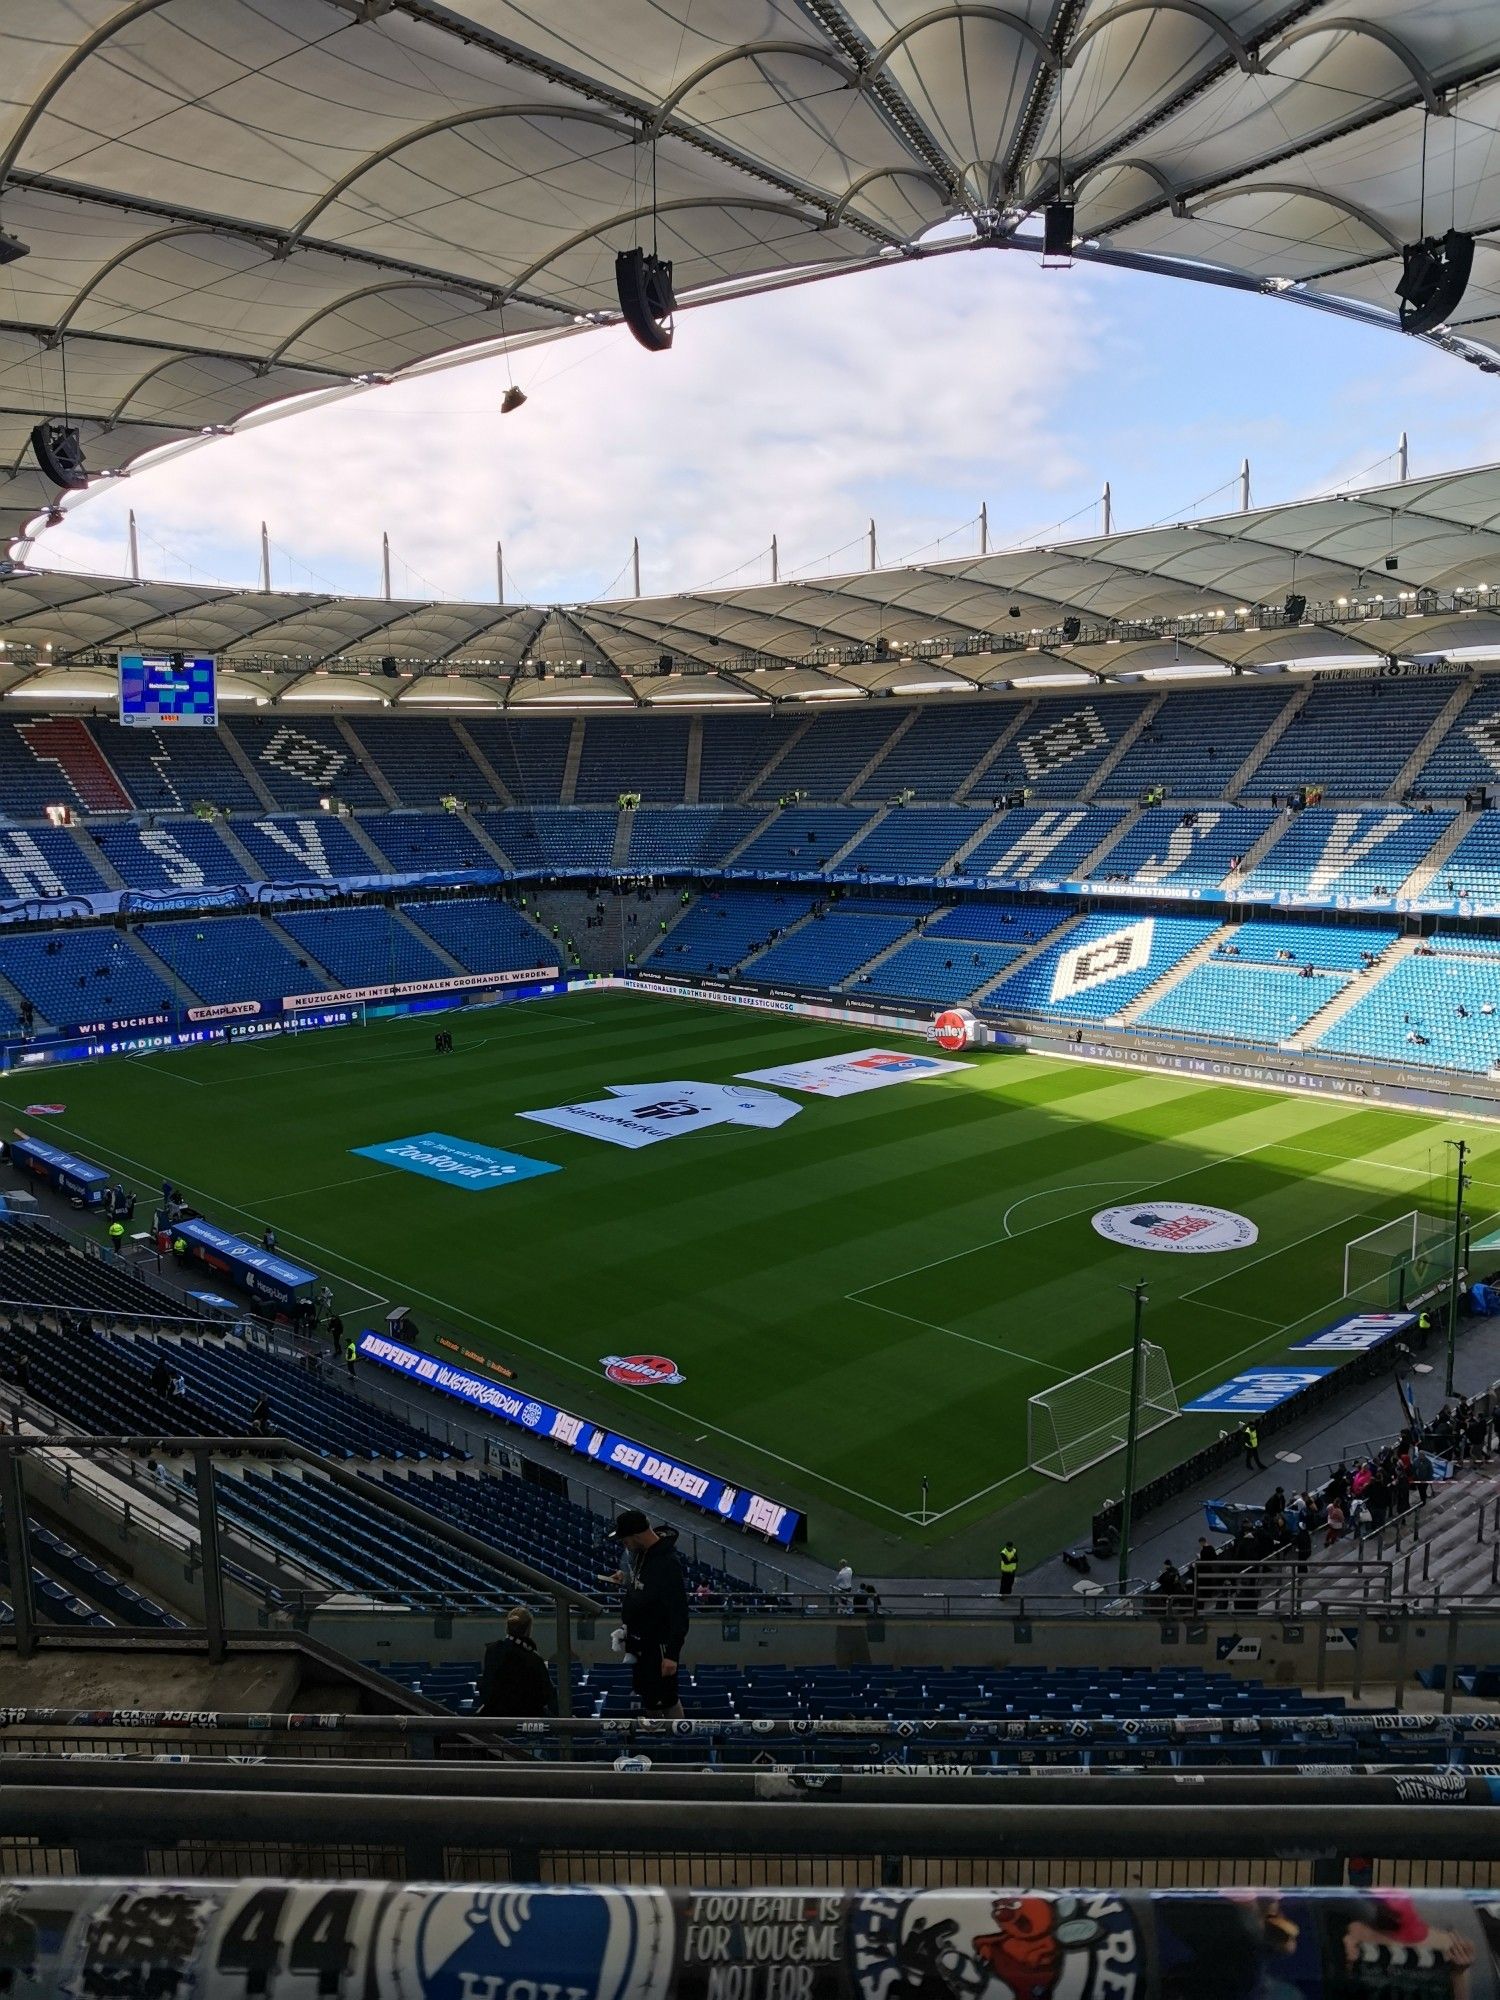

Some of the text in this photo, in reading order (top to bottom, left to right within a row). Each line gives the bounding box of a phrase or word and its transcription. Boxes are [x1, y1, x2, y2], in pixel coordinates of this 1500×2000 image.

[1091, 884, 1190, 898] VOLKSPARKSTADION
[295, 992, 352, 1005] NEUZUGANG
[355, 989, 367, 997] IM
[369, 981, 450, 996] INTERNATIONALEN
[512, 970, 550, 980] WERDEN.
[624, 980, 677, 994] INTERNATIONALER
[679, 989, 707, 999] PARTNER
[193, 1004, 255, 1019] TEAMPLAYER
[79, 1023, 105, 1033] WIR
[89, 1045, 104, 1055] IM
[111, 1035, 172, 1054] STADION
[178, 1031, 204, 1044] WIE
[209, 1028, 225, 1038] IM
[323, 1012, 347, 1024] WIR
[1069, 1044, 1083, 1053] IM
[1089, 1048, 1148, 1063] STADION
[1155, 1056, 1181, 1067] WIE
[1189, 1060, 1205, 1071] IM
[559, 1105, 674, 1138] HanseMerkur
[385, 1144, 492, 1178] ZooRoyal
[599, 1355, 686, 1384] Smiley's
[360, 1334, 420, 1369] ANPFIFF
[415, 1358, 439, 1379] IM
[549, 1410, 584, 1447] HSV
[610, 1443, 645, 1470] SEI
[743, 1494, 787, 1535] HSV
[1375, 1716, 1399, 1728] HSV
[1396, 1781, 1426, 1801] HATE
[693, 1896, 842, 1921] FOOTBALL IS
[217, 1888, 357, 1995] 44
[685, 1924, 731, 1961] FOR
[708, 1965, 816, 2000] NOT FOR
